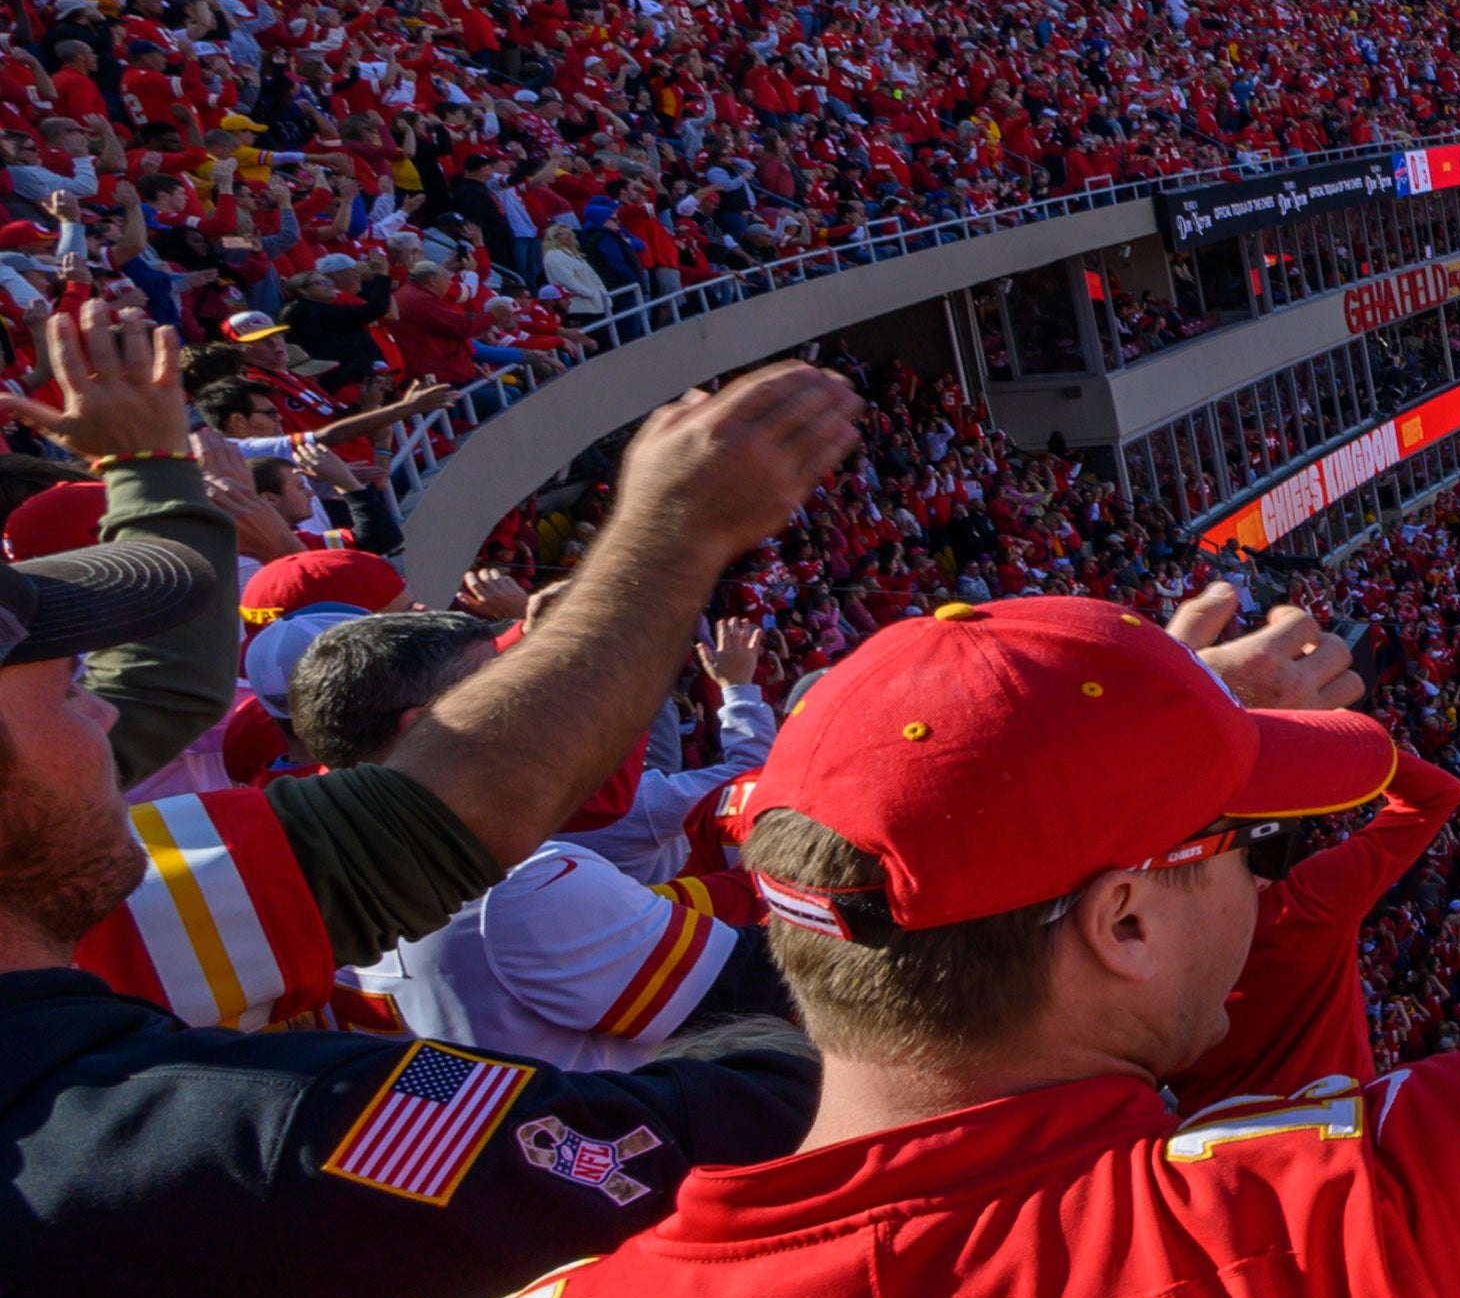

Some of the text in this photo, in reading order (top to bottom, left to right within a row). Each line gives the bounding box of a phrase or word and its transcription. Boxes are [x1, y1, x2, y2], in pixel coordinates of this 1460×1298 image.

[1344, 278, 1401, 334] GEHA
[1396, 263, 1450, 315] FIELD
[1259, 466, 1325, 545] CHIEFS
[1320, 420, 1402, 505] KINGDOM
[573, 1145, 611, 1181] NFL
